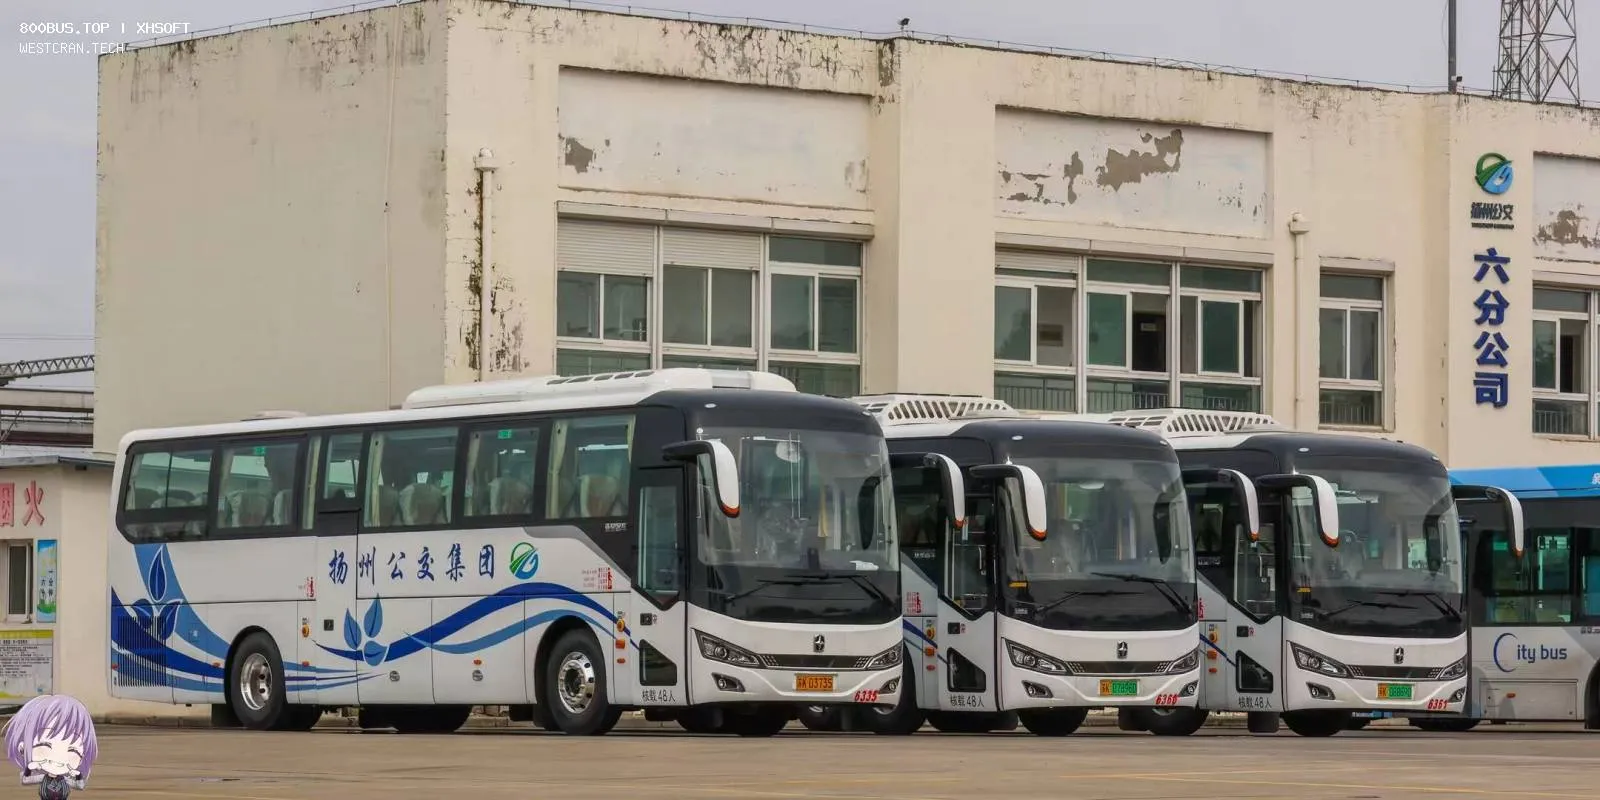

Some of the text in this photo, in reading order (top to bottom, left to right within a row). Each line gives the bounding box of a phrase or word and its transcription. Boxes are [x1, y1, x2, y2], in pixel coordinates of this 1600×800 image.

[1473, 247, 1510, 409] 六分公司
[328, 543, 496, 585] 扬州公交集团
[1493, 632, 1568, 673] City bus
[854, 690, 879, 703] 6335
[1427, 698, 1449, 710] 6361
